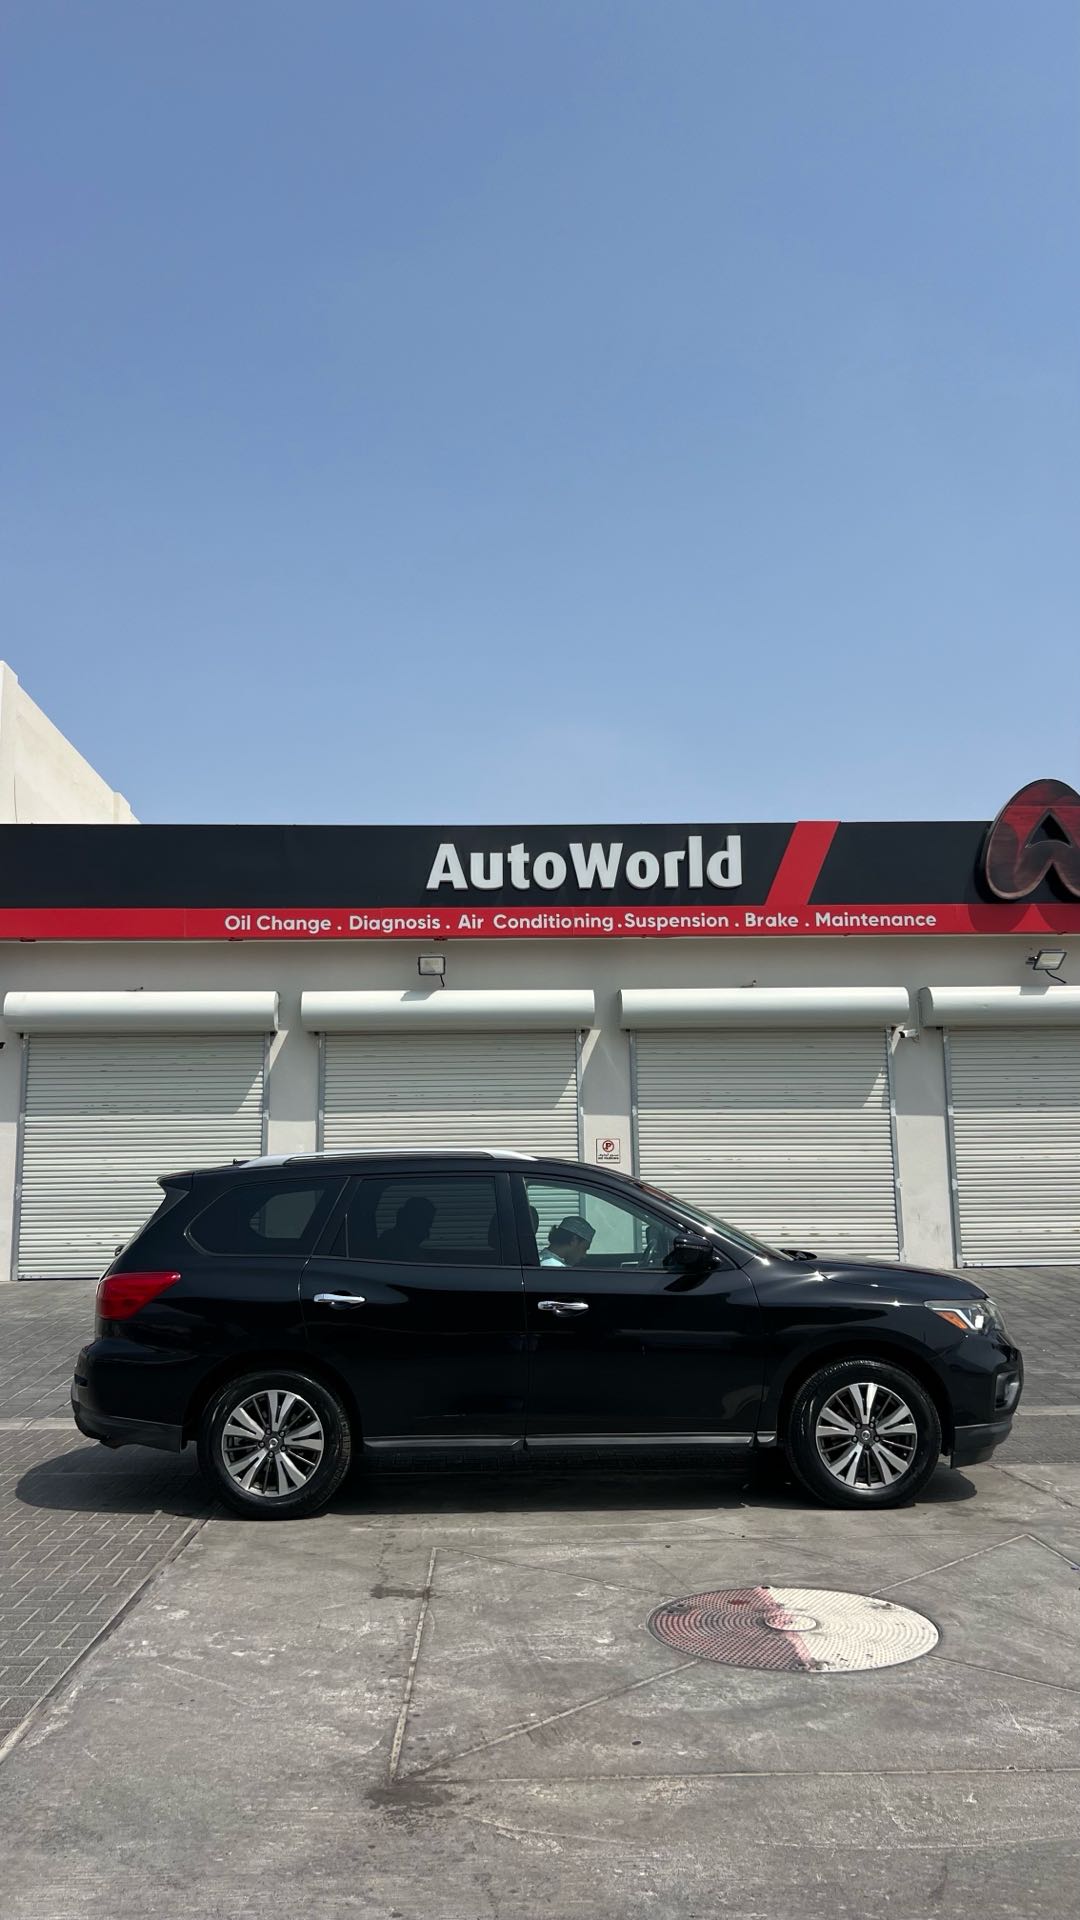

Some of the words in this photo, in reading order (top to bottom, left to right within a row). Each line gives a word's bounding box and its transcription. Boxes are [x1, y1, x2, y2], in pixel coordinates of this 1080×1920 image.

[426, 834, 743, 890] AutoWorld
[224, 914, 251, 931] Oil
[256, 915, 332, 934] Change
[349, 914, 441, 934] Diagnosis
[457, 913, 485, 930] Air
[493, 912, 614, 932] Conditioning
[745, 912, 799, 928] Brake
[815, 911, 937, 928] Maintenance
